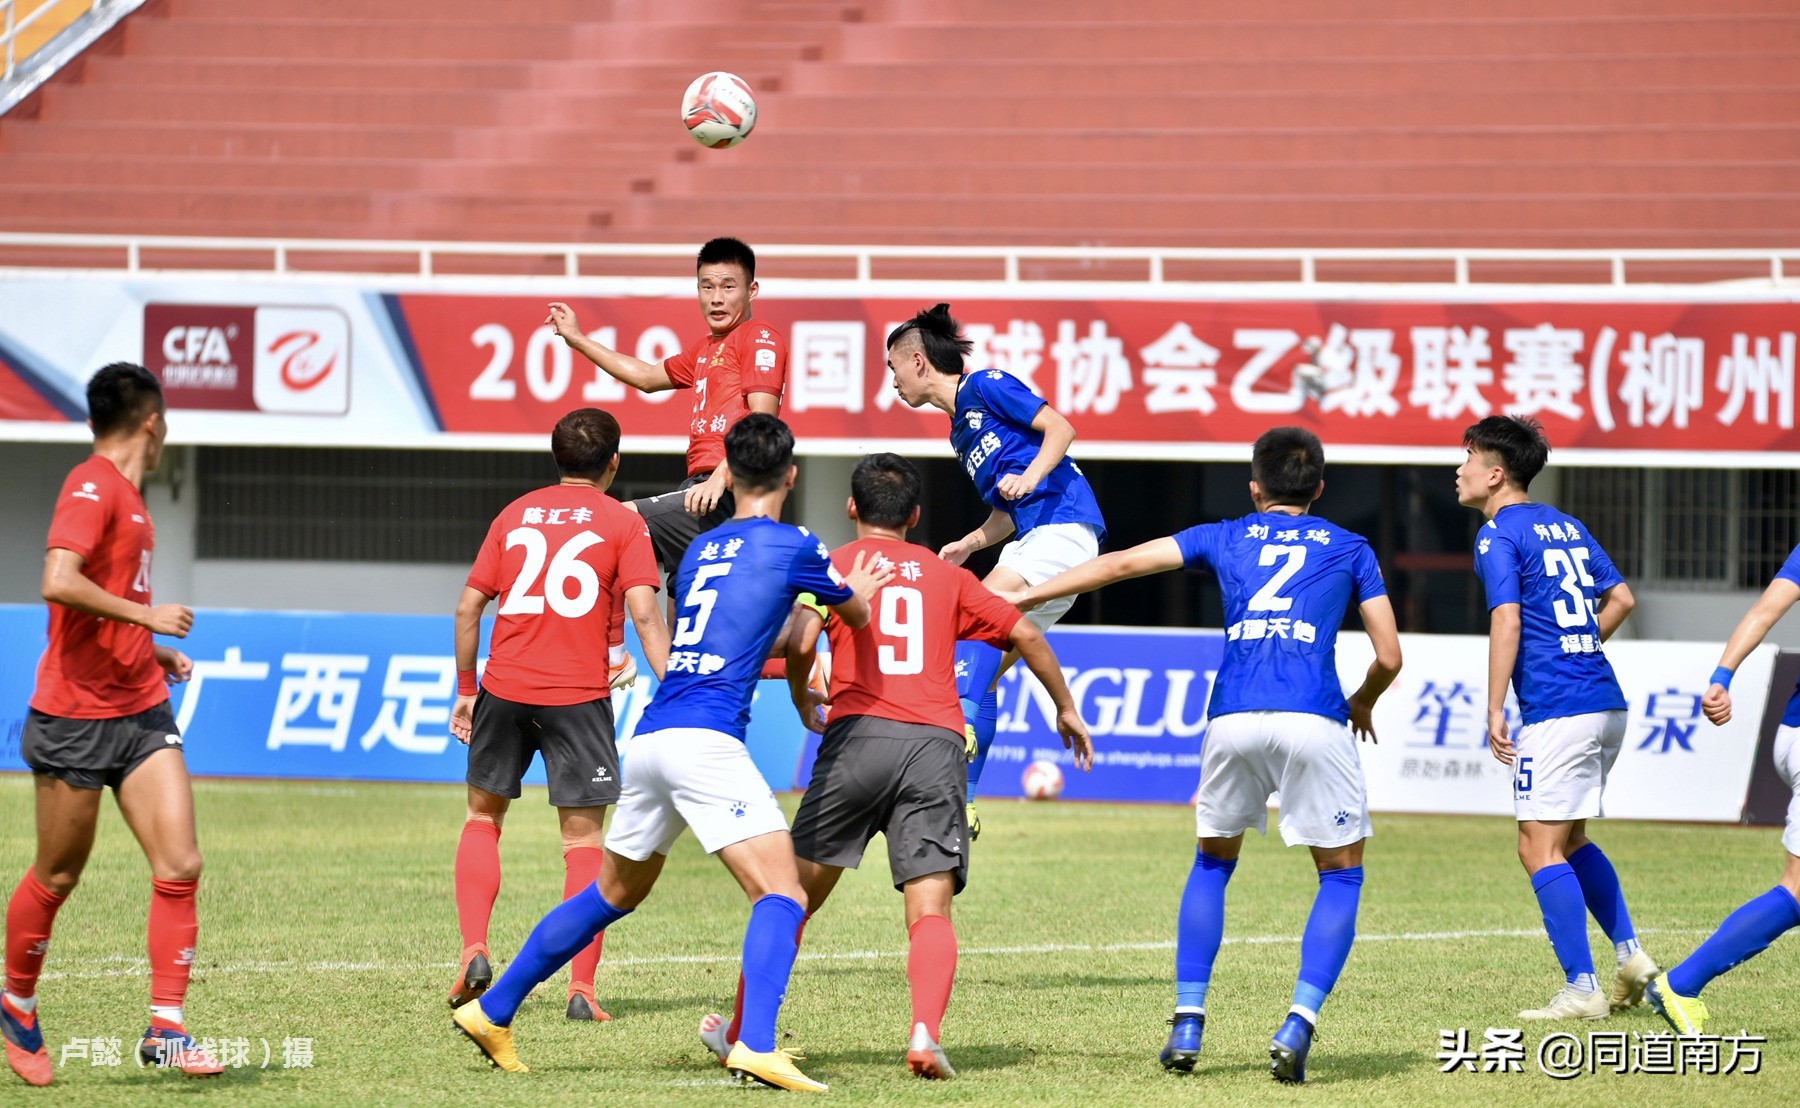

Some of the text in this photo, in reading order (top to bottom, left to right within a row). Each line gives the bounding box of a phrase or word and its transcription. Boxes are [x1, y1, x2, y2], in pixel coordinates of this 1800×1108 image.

[162, 326, 232, 364] CFA
[521, 507, 594, 525] 陈汇丰
[498, 527, 606, 618] 26
[672, 562, 733, 647] 5
[1247, 544, 1308, 612] 2
[1543, 546, 1600, 629] 35
[878, 585, 924, 675] 9
[1404, 677, 1706, 752] 笙泉
[1513, 757, 1533, 792] 5
